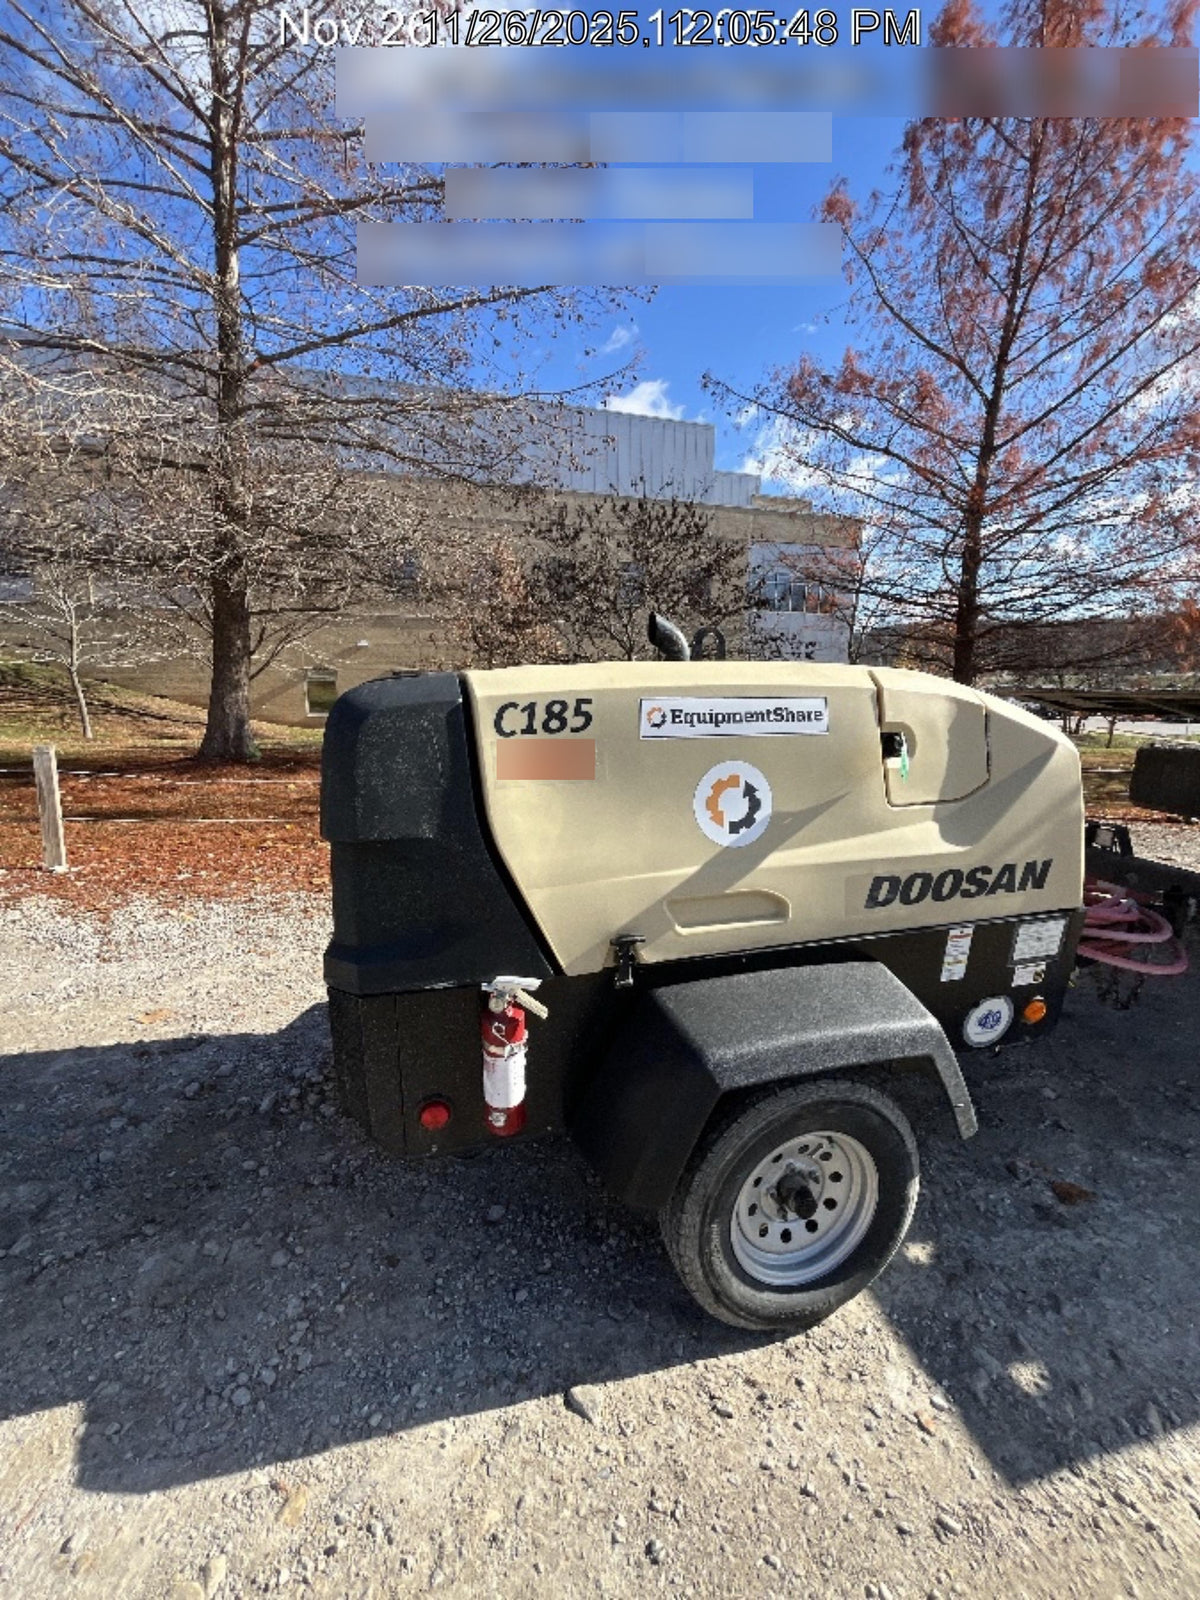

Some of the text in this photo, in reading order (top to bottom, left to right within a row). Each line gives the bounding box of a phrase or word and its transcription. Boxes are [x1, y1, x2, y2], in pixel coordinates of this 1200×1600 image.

[494, 698, 593, 738] C185
[670, 705, 824, 728] EquipmentShare
[864, 858, 1053, 909] DOOSAN
